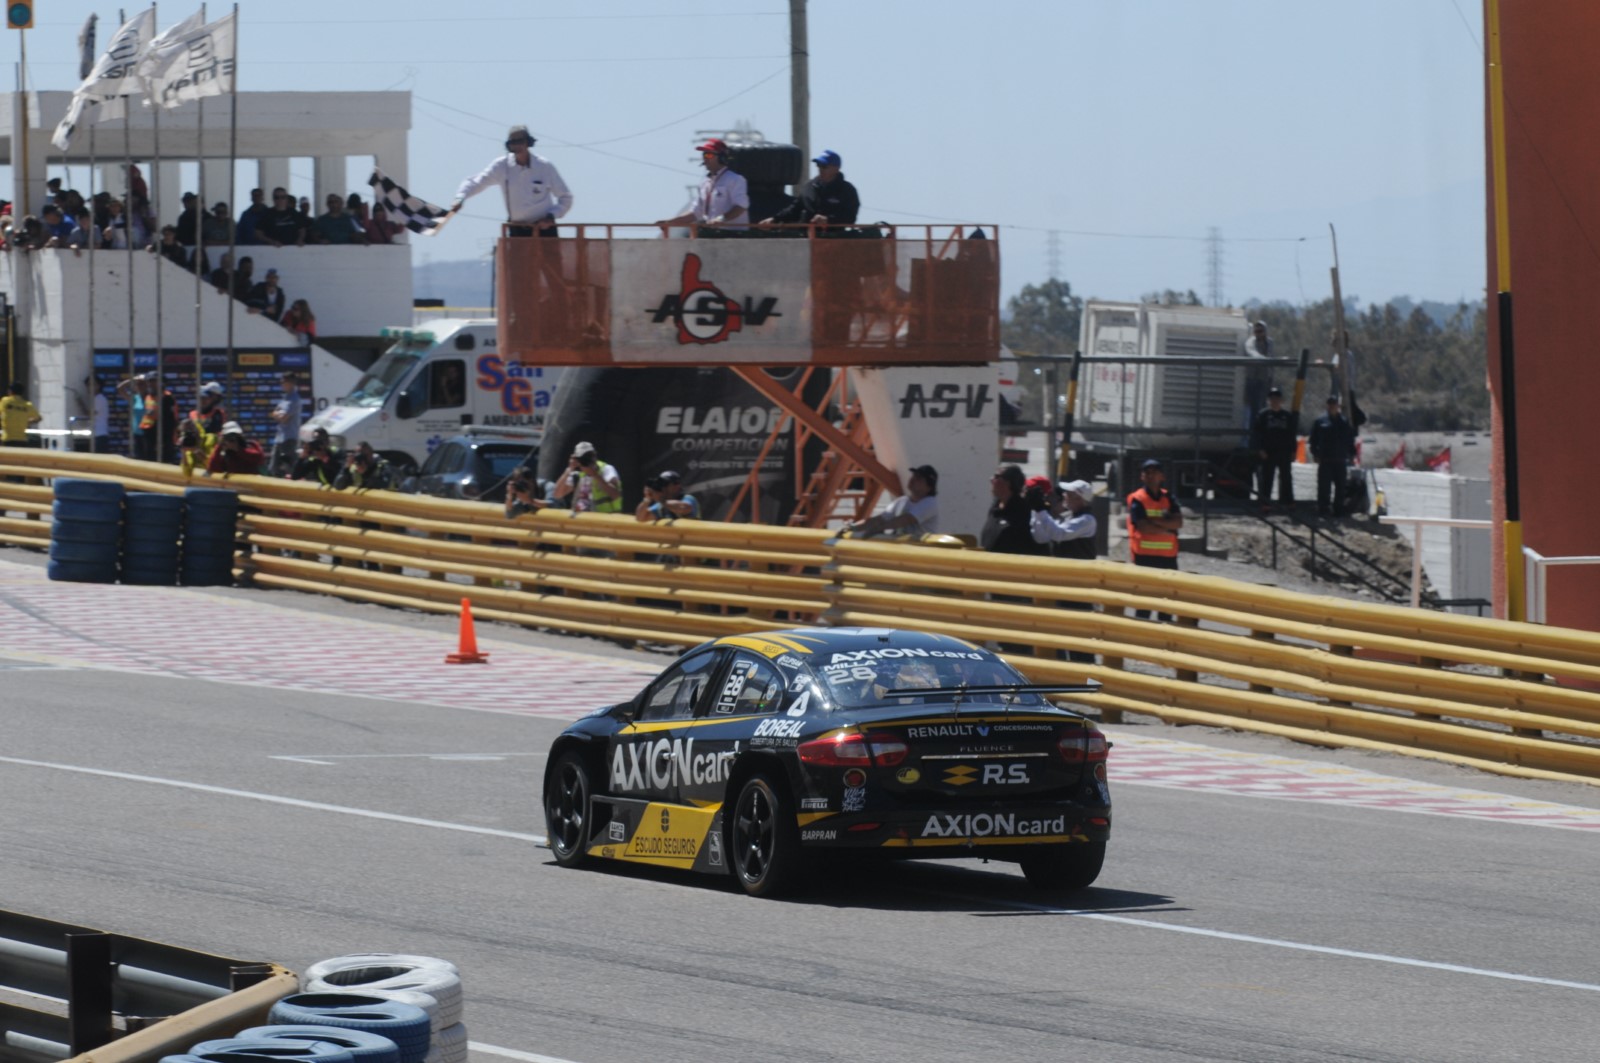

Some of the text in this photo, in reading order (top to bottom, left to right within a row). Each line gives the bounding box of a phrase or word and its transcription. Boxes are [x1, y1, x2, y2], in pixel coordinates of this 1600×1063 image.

[646, 293, 782, 326] ASV
[899, 383, 993, 418] ASV
[831, 648, 984, 664] AXION card
[824, 660, 878, 672] MILLA
[826, 666, 878, 685] 28
[723, 674, 745, 696] 28
[753, 718, 806, 738] BOREAL
[907, 724, 1053, 738] RENAULT CONCESIONARIOS
[960, 745, 1015, 753] FLUENCE
[609, 737, 694, 792] AXION
[801, 797, 829, 809] PIRELLI
[920, 813, 1065, 837] AXION card
[801, 830, 837, 841] BARPRAN
[634, 836, 663, 854] ESCUDO
[663, 838, 696, 856] SEGUROS
